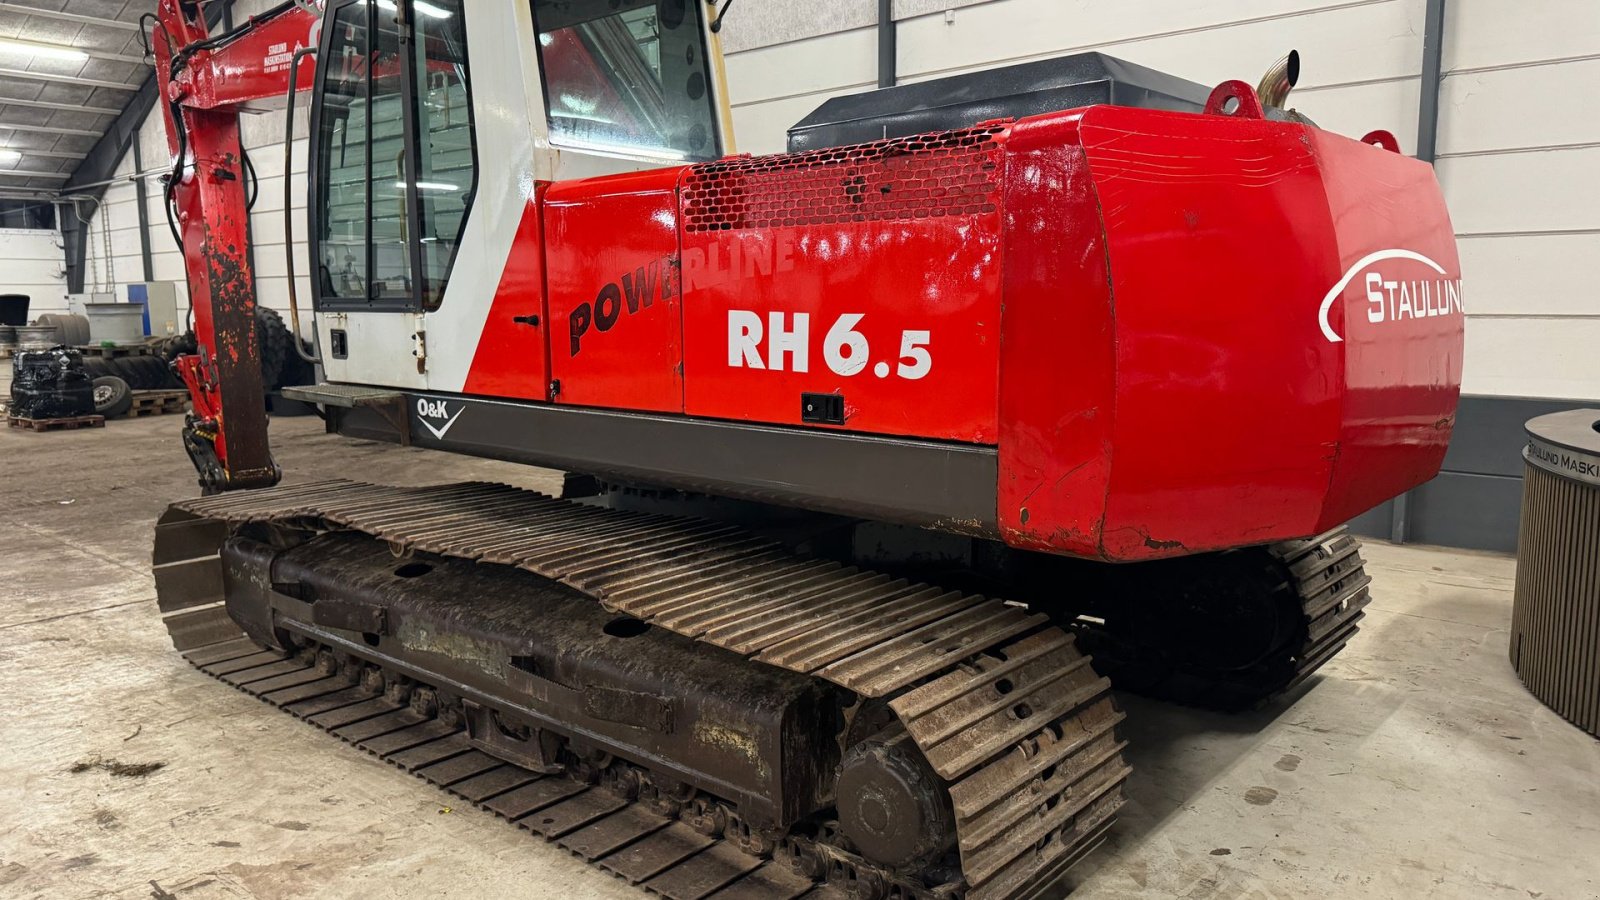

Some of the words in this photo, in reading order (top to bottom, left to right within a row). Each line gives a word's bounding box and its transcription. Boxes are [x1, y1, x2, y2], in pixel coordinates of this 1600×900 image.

[569, 230, 796, 358] POWERLINE
[727, 309, 809, 373] RH
[823, 313, 932, 380] 6.5
[417, 398, 449, 419] O&K
